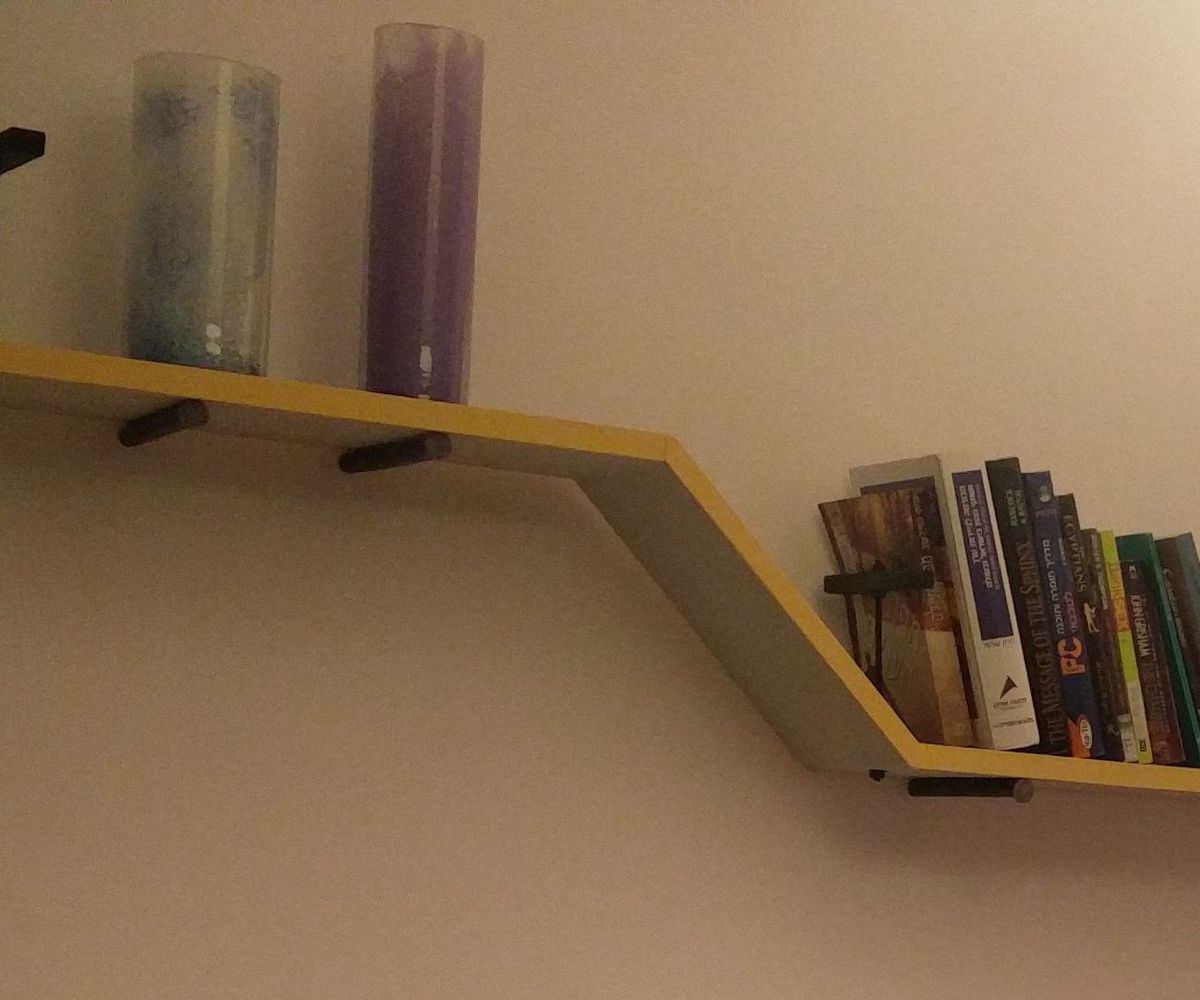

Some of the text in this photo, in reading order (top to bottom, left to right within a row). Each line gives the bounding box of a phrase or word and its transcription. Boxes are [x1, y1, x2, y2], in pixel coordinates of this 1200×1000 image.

[1060, 513, 1088, 593] EGYPTIANS
[1015, 539, 1066, 743] THE MESSAGE OF THE SPHINX
[1054, 635, 1087, 676] PC
[1129, 593, 1153, 657] JOHN GRISHAM
